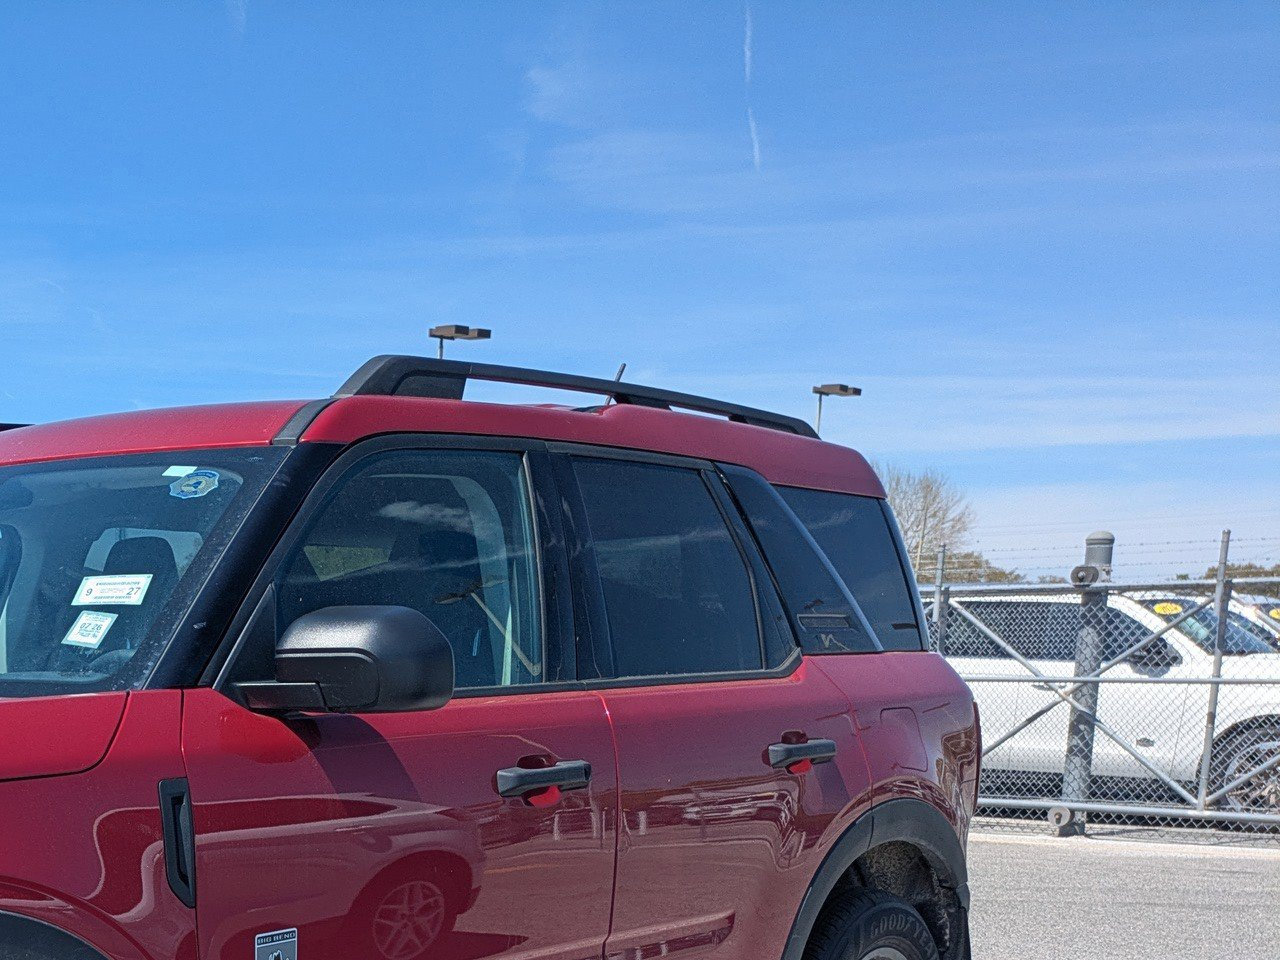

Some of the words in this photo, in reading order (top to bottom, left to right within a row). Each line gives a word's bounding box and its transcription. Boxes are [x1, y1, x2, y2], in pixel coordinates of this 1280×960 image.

[85, 588, 93, 596] 9
[126, 586, 141, 596] 27
[273, 932, 296, 941] BEND
